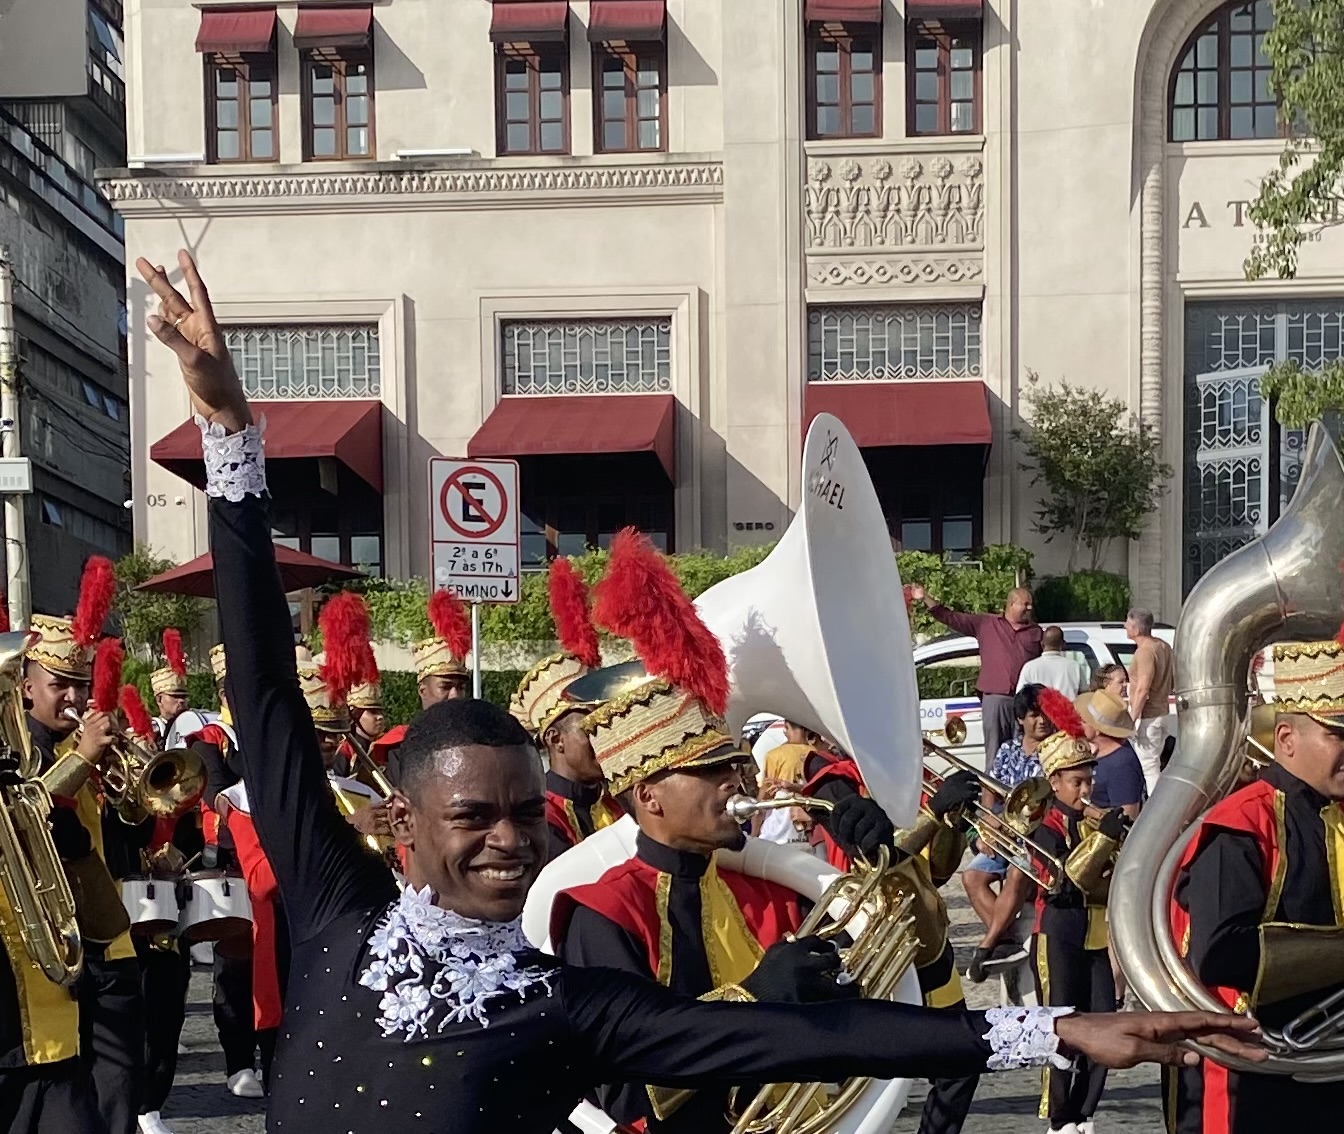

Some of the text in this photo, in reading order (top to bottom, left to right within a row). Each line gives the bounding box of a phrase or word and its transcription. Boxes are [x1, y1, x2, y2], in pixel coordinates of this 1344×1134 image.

[1182, 201, 1211, 228] A
[471, 550, 478, 559] a
[448, 558, 503, 573] 7 às 17h
